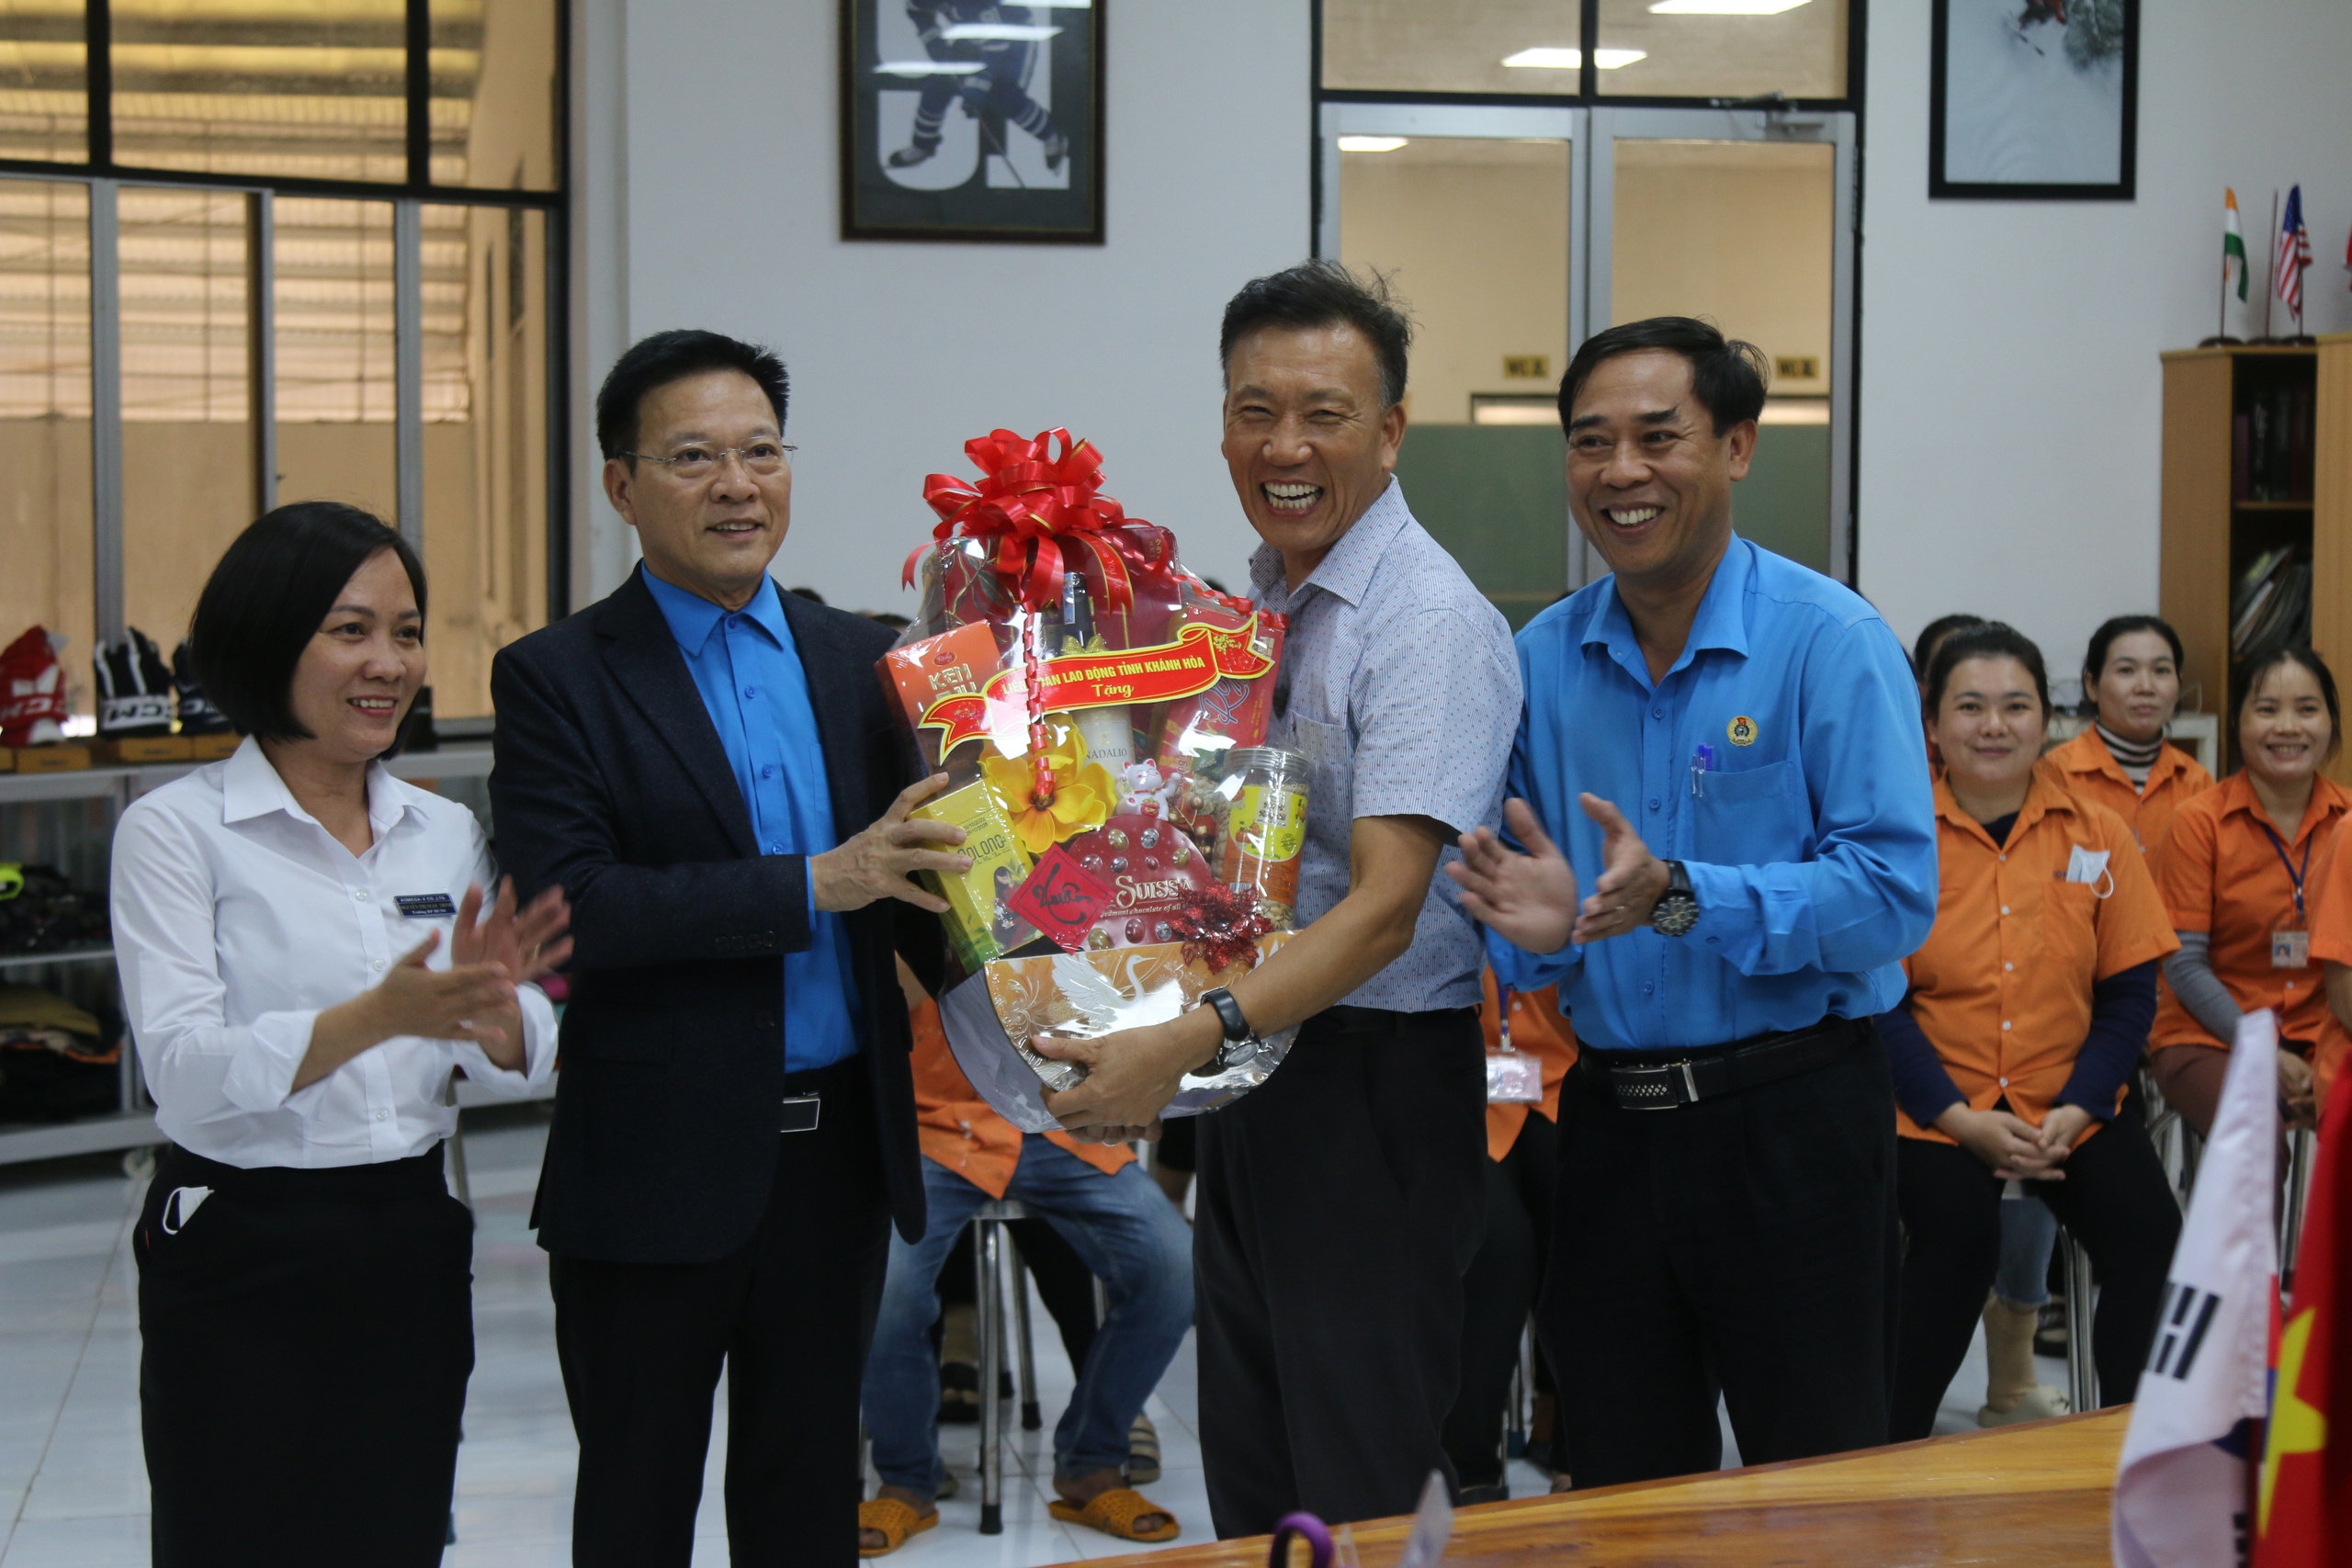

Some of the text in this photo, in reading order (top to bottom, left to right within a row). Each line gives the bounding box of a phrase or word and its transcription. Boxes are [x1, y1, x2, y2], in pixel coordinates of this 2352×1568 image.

[1038, 672, 1062, 689] OÀN
[1062, 669, 1084, 683] LAO
[1086, 665, 1116, 682] ĐỘNG
[1116, 660, 1144, 676] TỈNH
[1145, 658, 1182, 673] KHÁNH
[1184, 655, 1206, 670] HÒA
[1091, 683, 1135, 699] Tặng
[1100, 902, 1182, 919] iedmont chocolate of all
